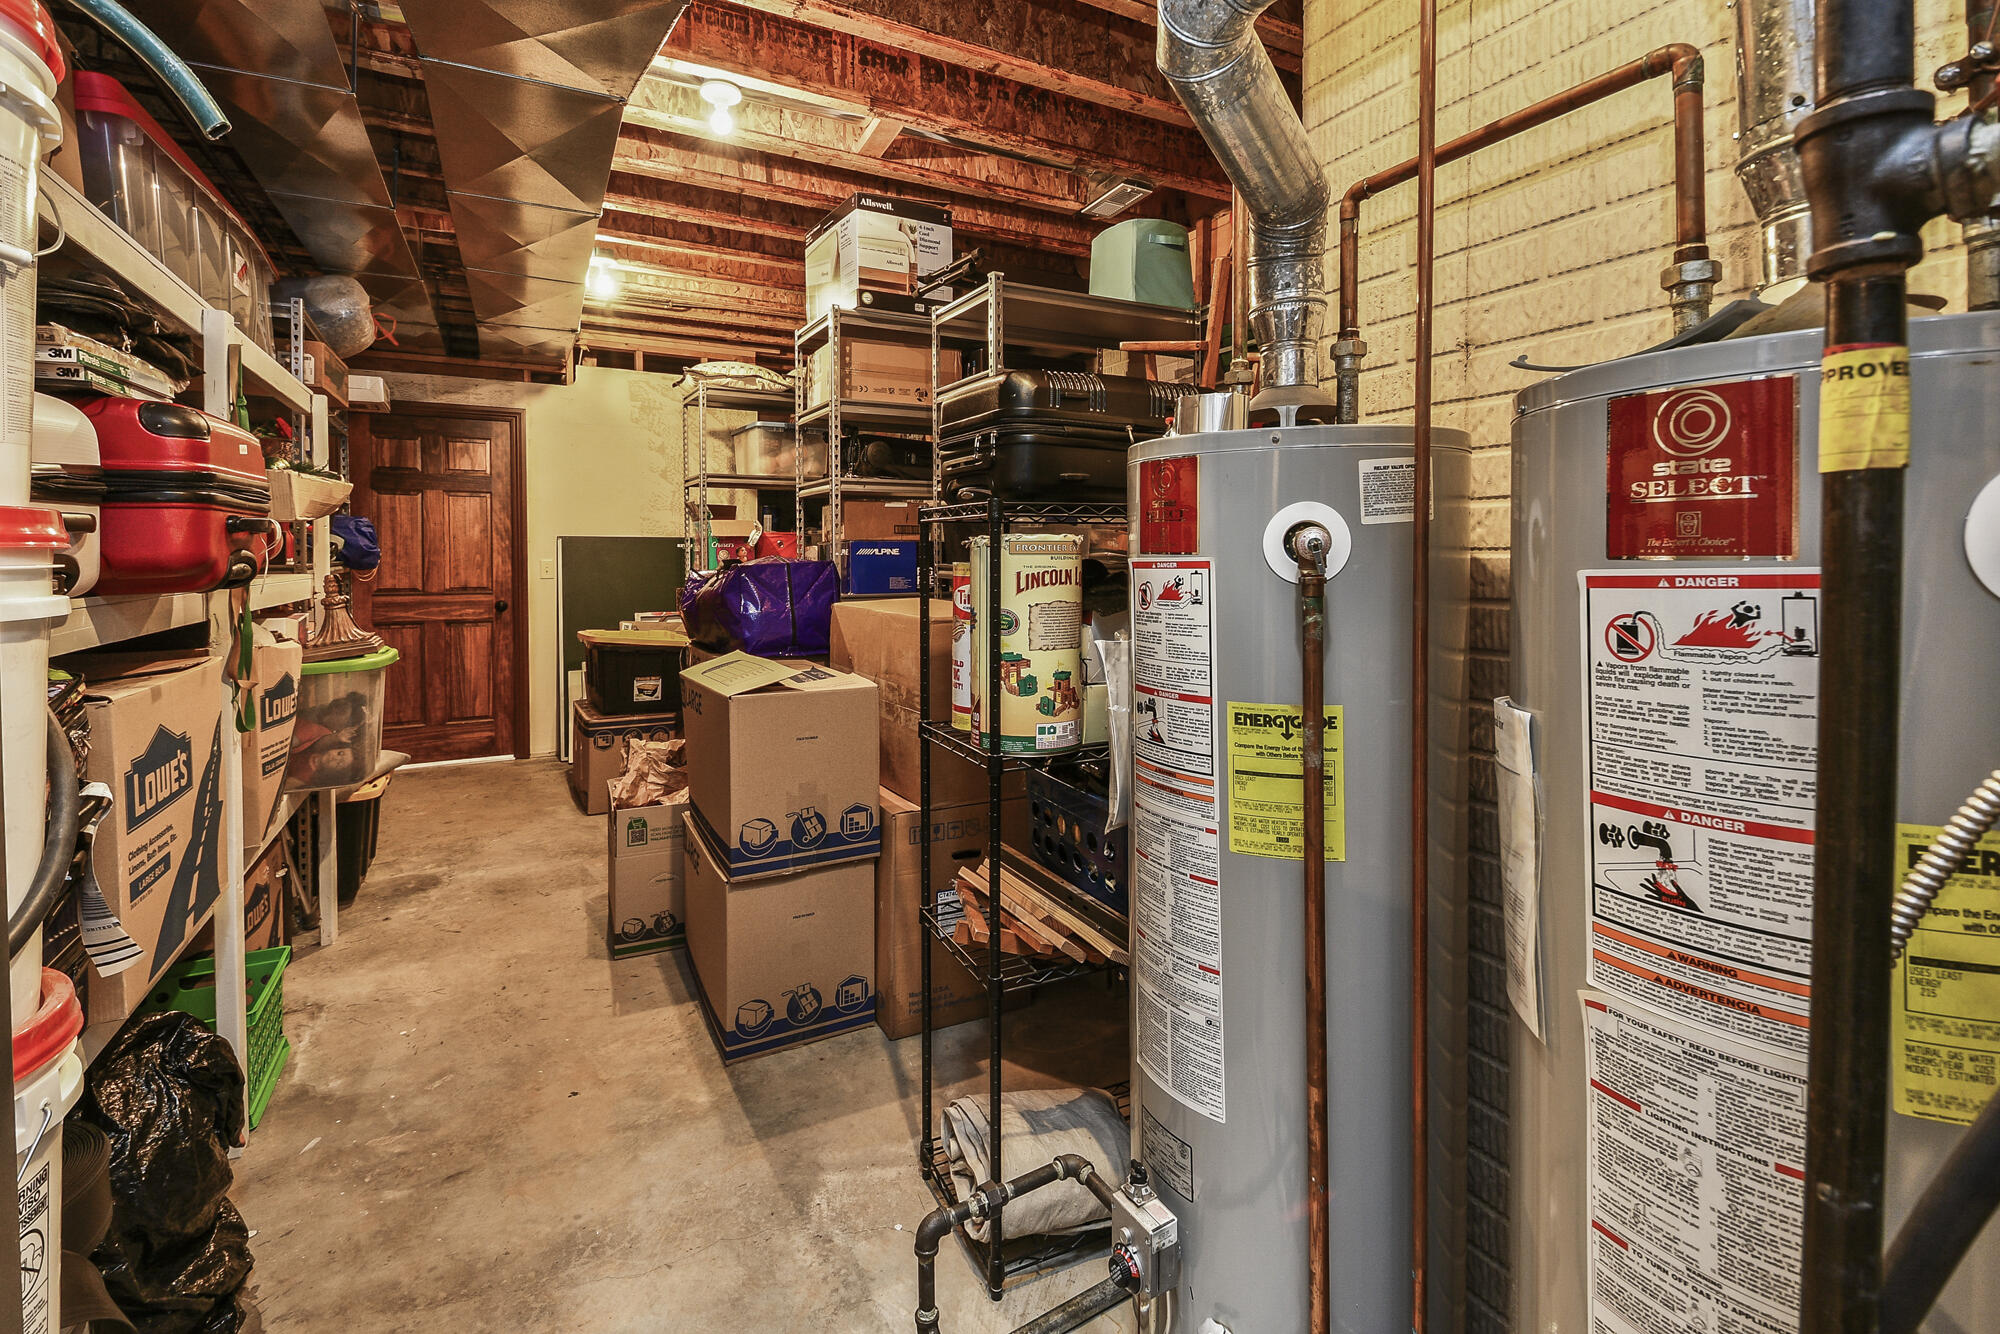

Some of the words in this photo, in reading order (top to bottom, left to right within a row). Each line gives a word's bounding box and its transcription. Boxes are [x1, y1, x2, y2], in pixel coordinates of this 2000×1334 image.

[860, 198, 894, 211] Allswell.
[48, 348, 71, 358] 3M
[56, 367, 79, 377] 3M
[1653, 458, 1731, 476] state
[1630, 475, 1759, 498] SELECT
[1647, 538, 1661, 546] The
[1016, 569, 1072, 596] LINCOLN
[1675, 577, 1739, 587] DANGER
[1673, 651, 1716, 659] Flammable
[1718, 652, 1748, 661] Vapors
[1605, 662, 1628, 670] Vapors
[1649, 666, 1689, 675] flammable
[1627, 679, 1655, 687] causing
[1159, 691, 1179, 699] DANGER
[133, 750, 188, 818] LOWE'S
[1681, 812, 1746, 833] DANGER
[139, 871, 155, 891] LARGE
[1963, 908, 1981, 919] the
[1963, 923, 1987, 933] with
[1676, 953, 1738, 979] WARNING
[1909, 967, 1932, 977] USES
[1936, 970, 1963, 981] LEAST
[1909, 976, 1943, 988] ENERGY
[1664, 978, 1762, 1015] ADVERTENCIA
[1609, 1009, 1624, 1020] FOR
[1626, 1016, 1649, 1031] YOUR
[1651, 1027, 1686, 1045] SAFETY
[1689, 1042, 1715, 1056] READ
[1718, 1052, 1760, 1072] BEFORE
[1681, 1050, 1719, 1067] WARNING
[1905, 1044, 1942, 1058] NATURAL
[1947, 1051, 1964, 1061] GAS
[1968, 1054, 1995, 1065] WATER
[1974, 1064, 1995, 1075] COST
[1644, 1110, 1689, 1135] LIGHTING
[1691, 1131, 1769, 1168] INSTRUCTIONS
[1632, 1249, 1642, 1259] TO
[1645, 1257, 1670, 1278] TURN
[1671, 1273, 1689, 1287] OFF
[1691, 1285, 1711, 1301] GAS
[1714, 1298, 1729, 1309] TO
[1685, 1266, 1723, 1290] WARNING
